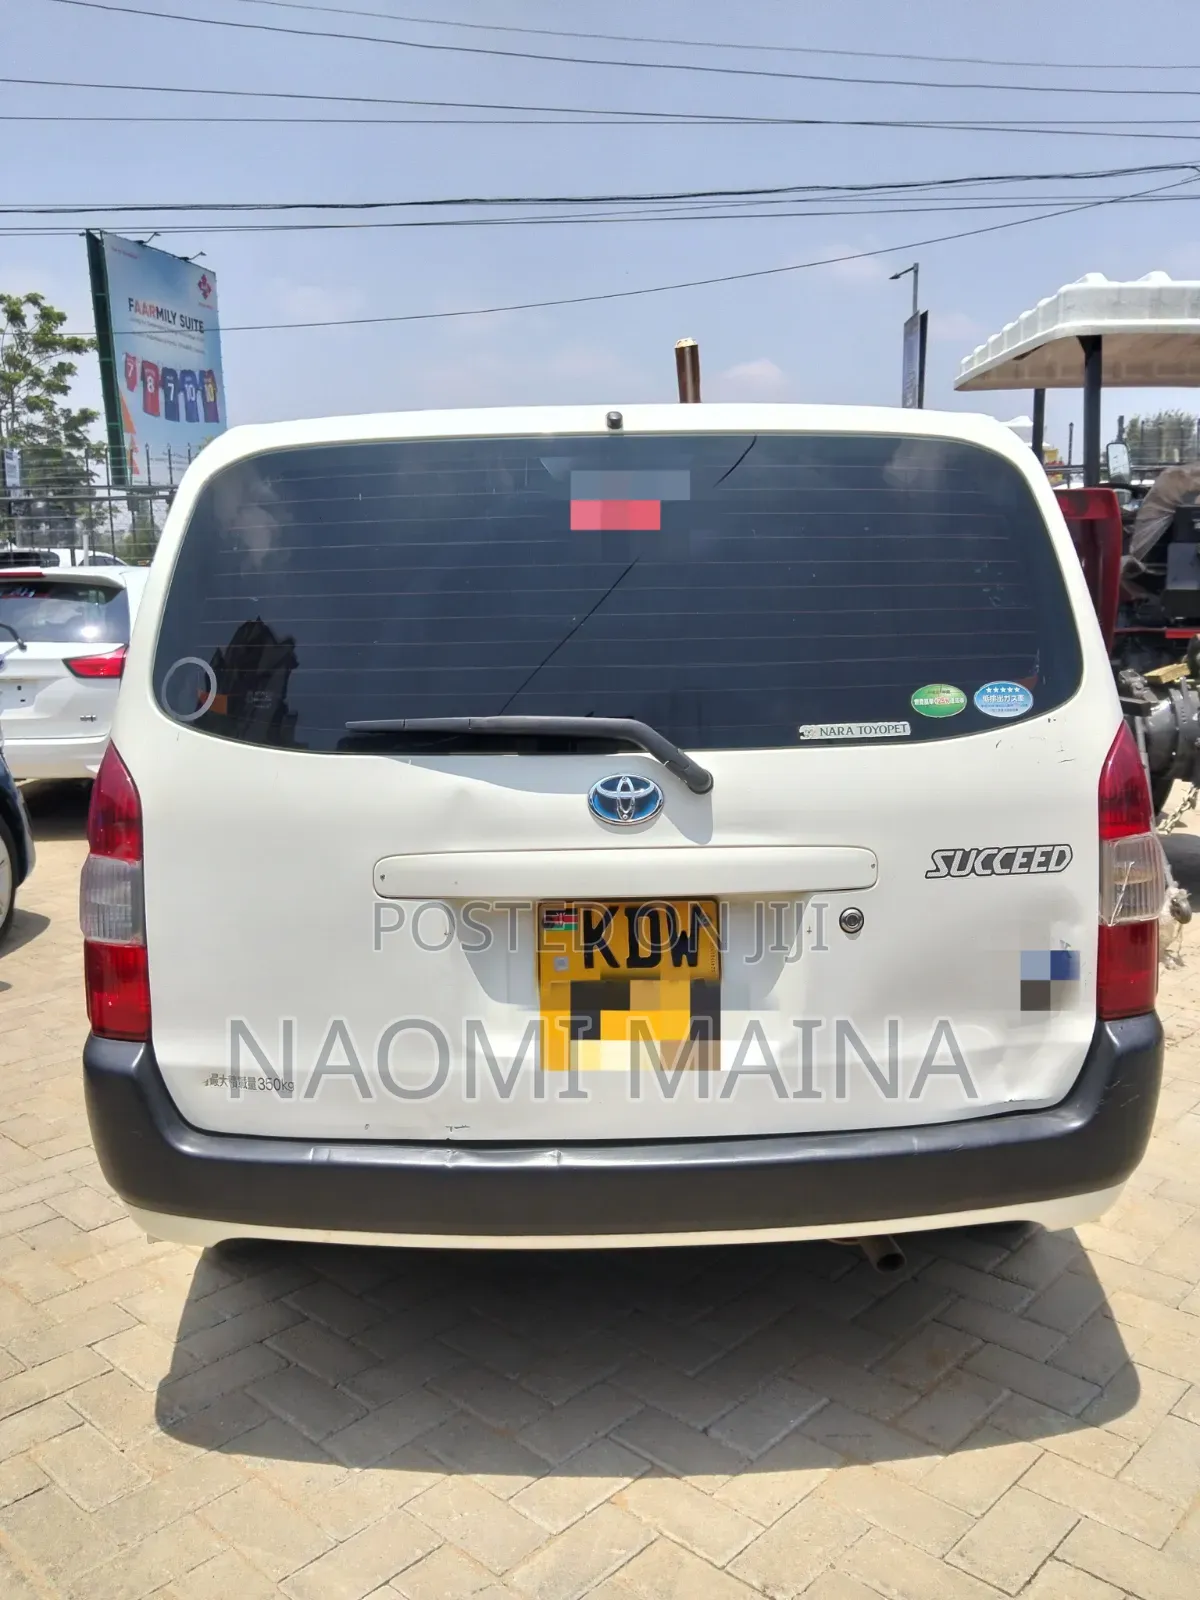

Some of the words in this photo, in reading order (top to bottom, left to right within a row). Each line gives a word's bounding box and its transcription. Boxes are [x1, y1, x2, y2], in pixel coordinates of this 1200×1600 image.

[127, 297, 177, 325] FAARMILY
[179, 314, 205, 333] SUITE
[146, 375, 155, 393] 8
[167, 382, 175, 401] 7
[184, 383, 196, 402] 10
[819, 725, 854, 737] NARA
[858, 723, 908, 735] TOYOPET
[925, 843, 1073, 879] SUCCEED
[582, 904, 700, 969] KDW
